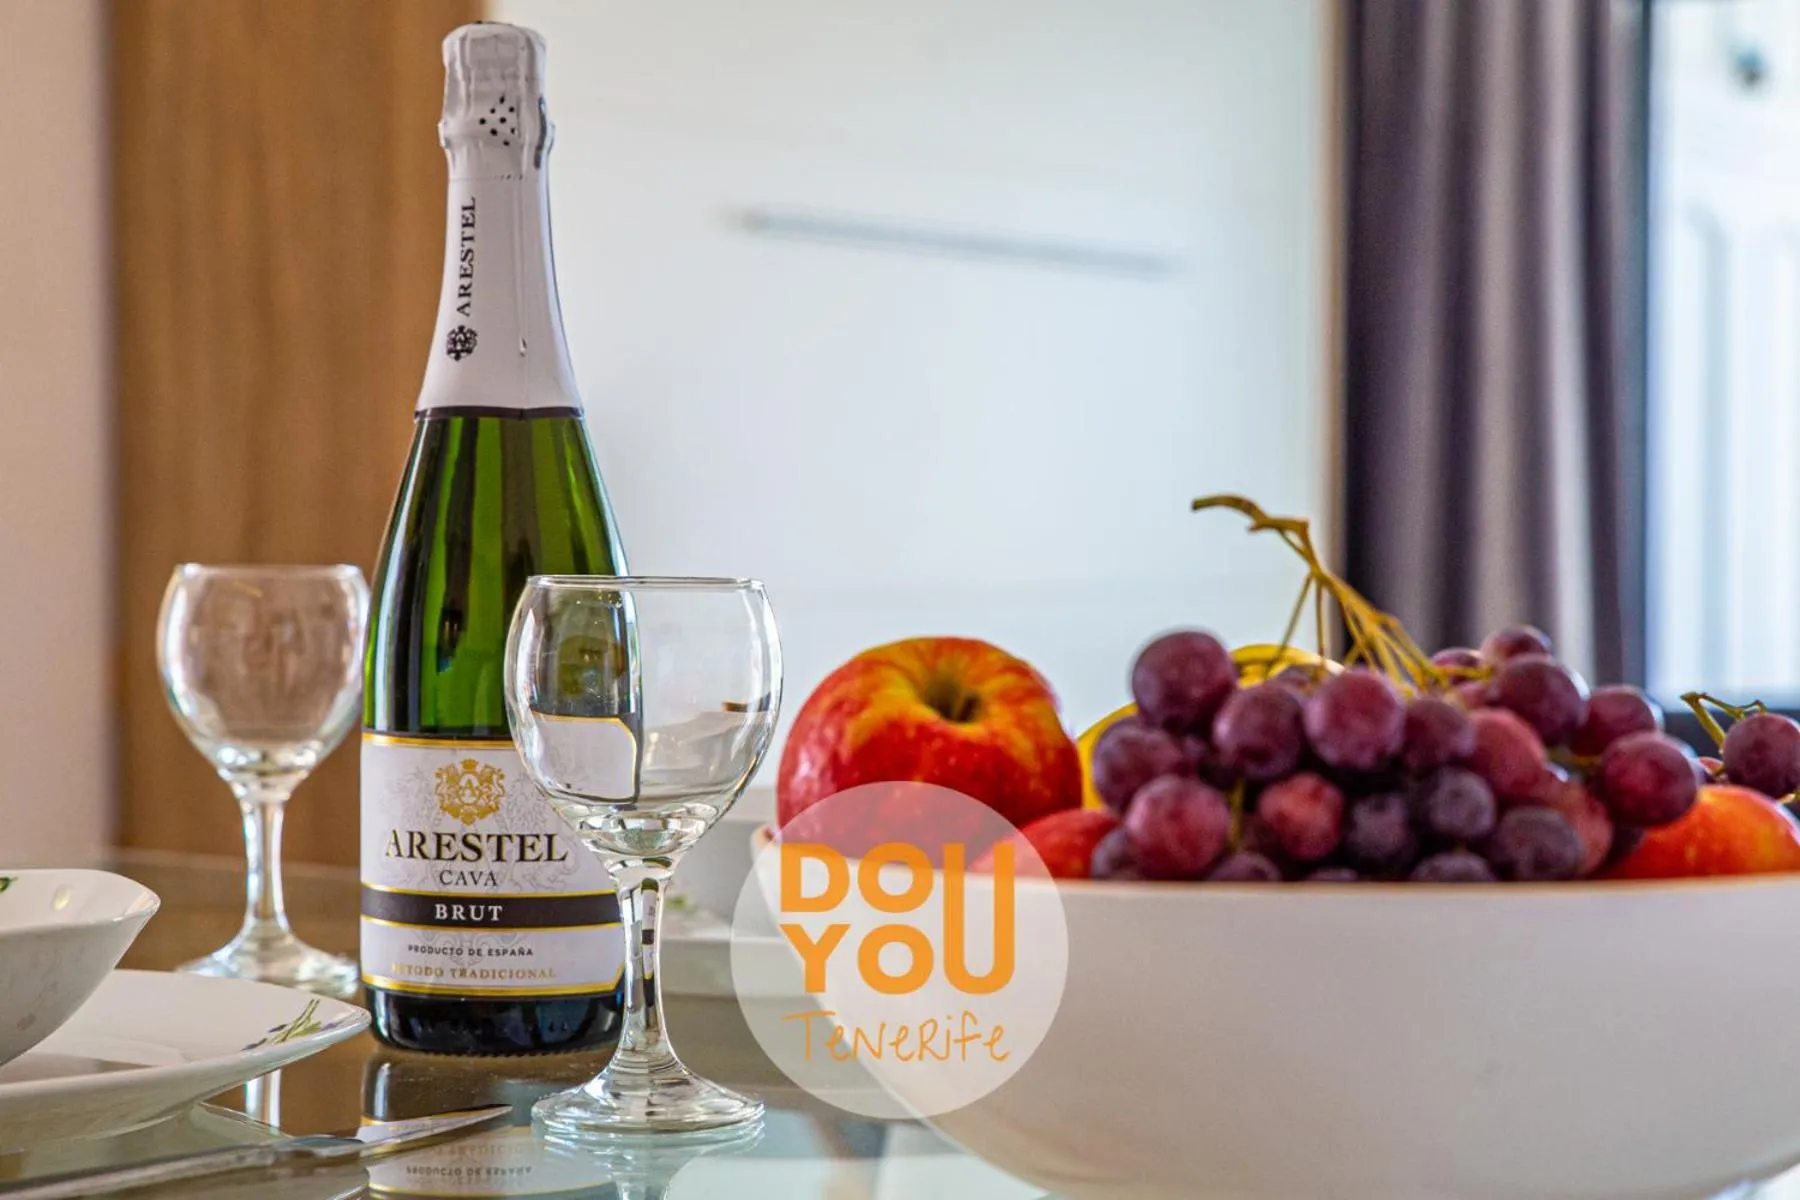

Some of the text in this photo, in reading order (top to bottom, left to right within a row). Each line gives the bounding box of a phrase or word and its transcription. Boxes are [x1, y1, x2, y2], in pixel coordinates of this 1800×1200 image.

[456, 196, 476, 317] ARESTEL
[385, 829, 569, 862] ARESTEL
[439, 869, 498, 887] CAVA
[435, 903, 503, 921] BRUT
[408, 944, 533, 957] PRODUCTO DE ESPAÑA
[450, 968, 557, 979] TRADICIONAL
